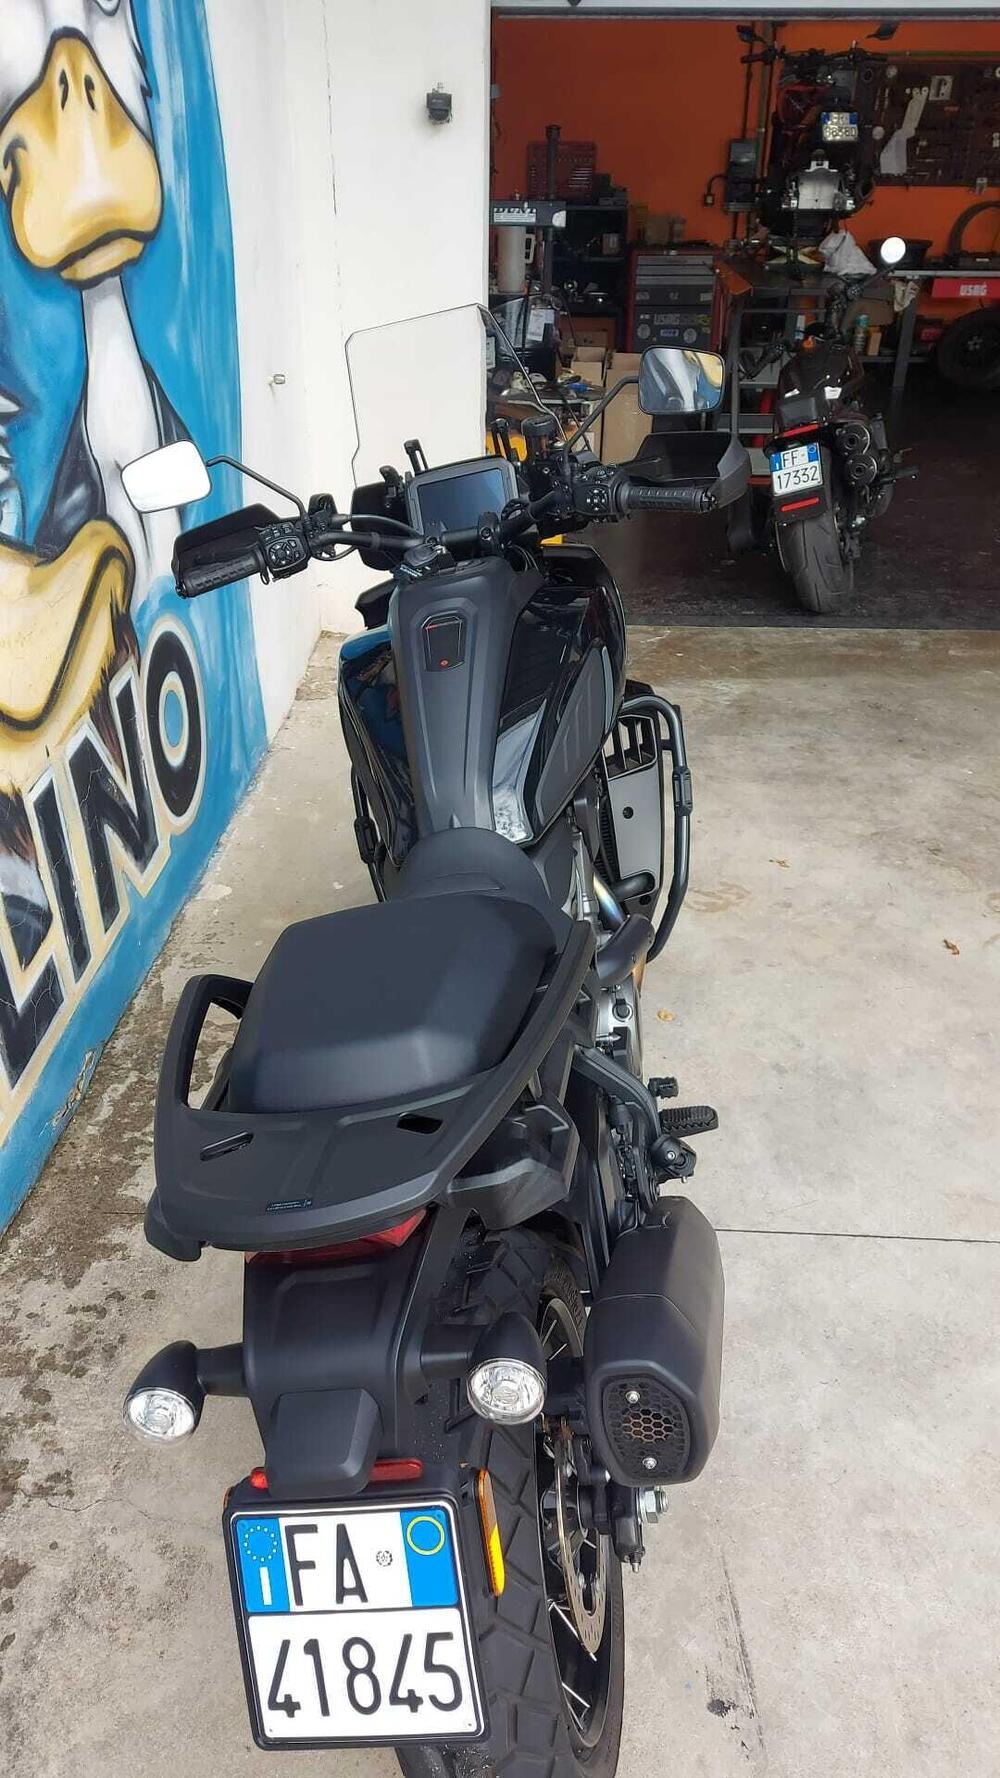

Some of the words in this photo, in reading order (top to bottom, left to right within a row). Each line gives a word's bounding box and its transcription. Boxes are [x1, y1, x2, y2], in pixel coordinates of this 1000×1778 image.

[777, 465, 819, 490] 17332
[782, 450, 799, 468] FF
[284, 1523, 369, 1606] FA
[267, 1631, 463, 1718] 41845
